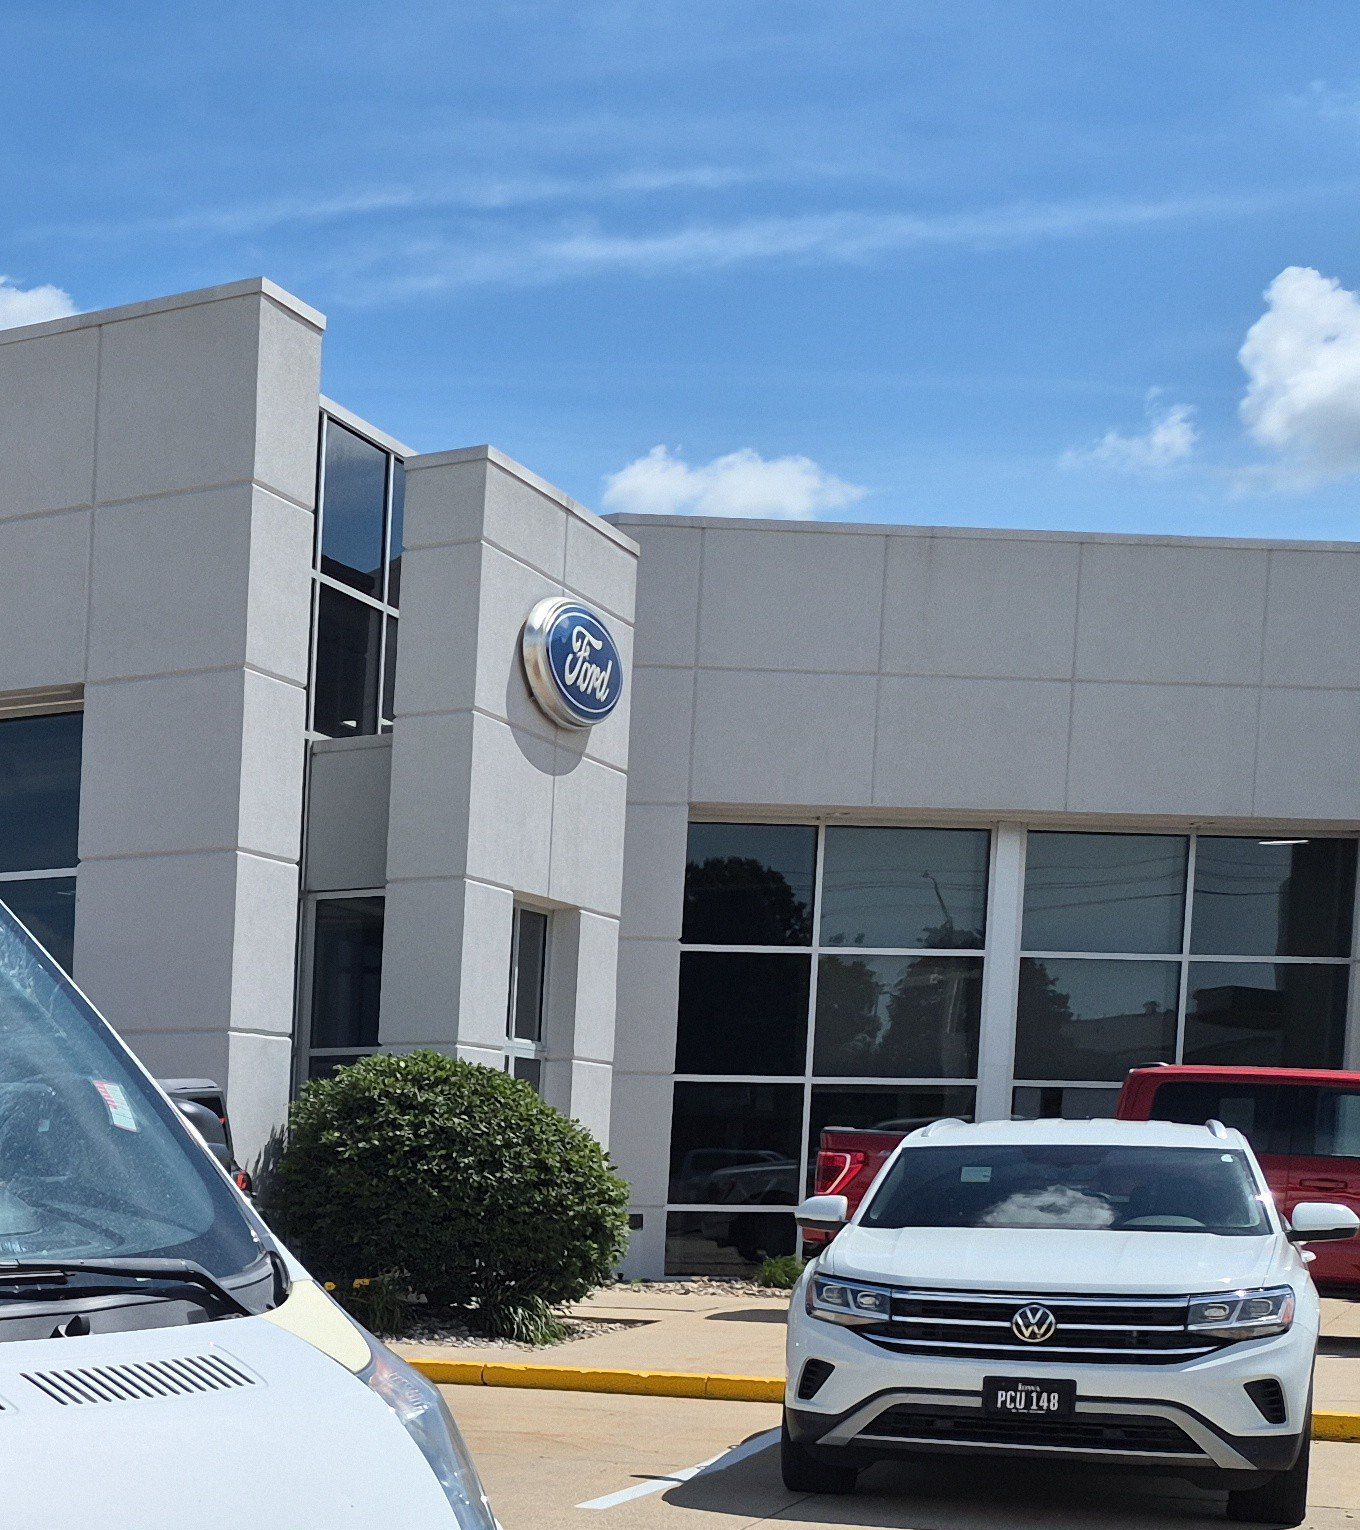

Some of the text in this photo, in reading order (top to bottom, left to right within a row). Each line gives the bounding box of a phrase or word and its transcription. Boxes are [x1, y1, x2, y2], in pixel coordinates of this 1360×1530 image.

[564, 625, 613, 702] Ford
[996, 1390, 1059, 1411] PCU 148
